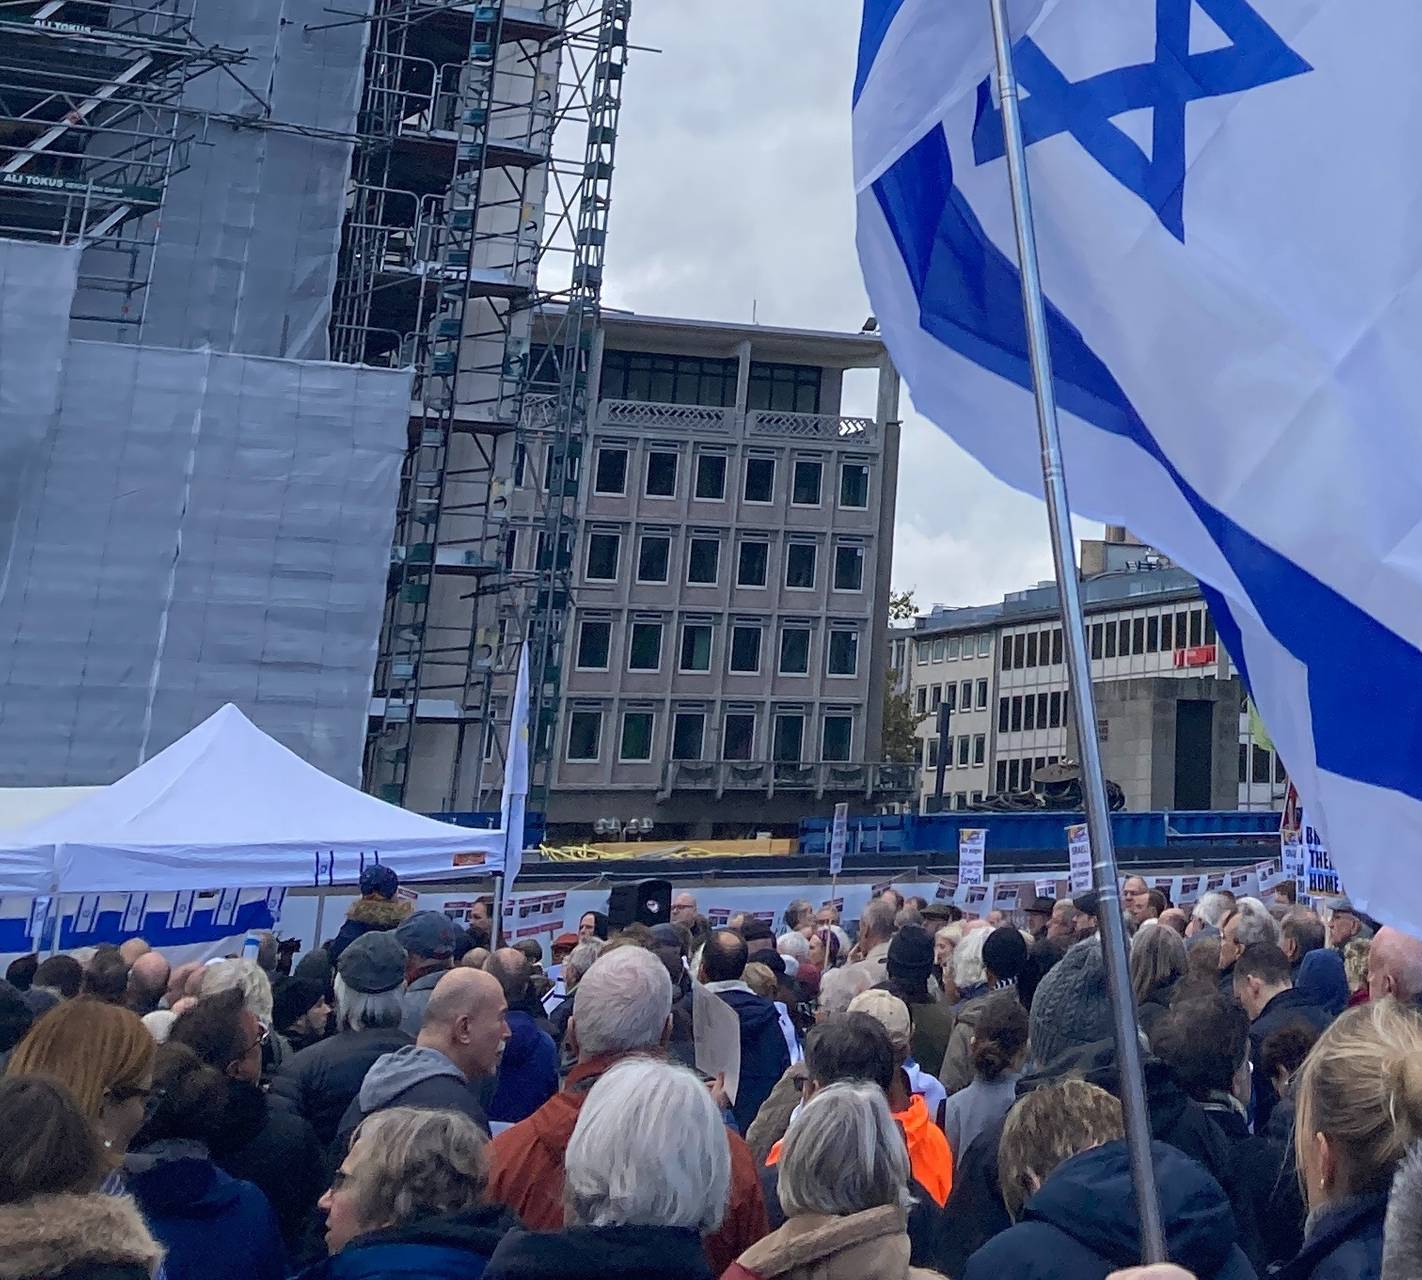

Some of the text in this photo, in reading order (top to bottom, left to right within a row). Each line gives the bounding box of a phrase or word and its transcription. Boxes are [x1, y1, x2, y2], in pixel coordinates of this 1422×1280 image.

[4, 174, 22, 183] ALI
[26, 175, 63, 188] TOKUS
[1309, 872, 1340, 895] HOME
